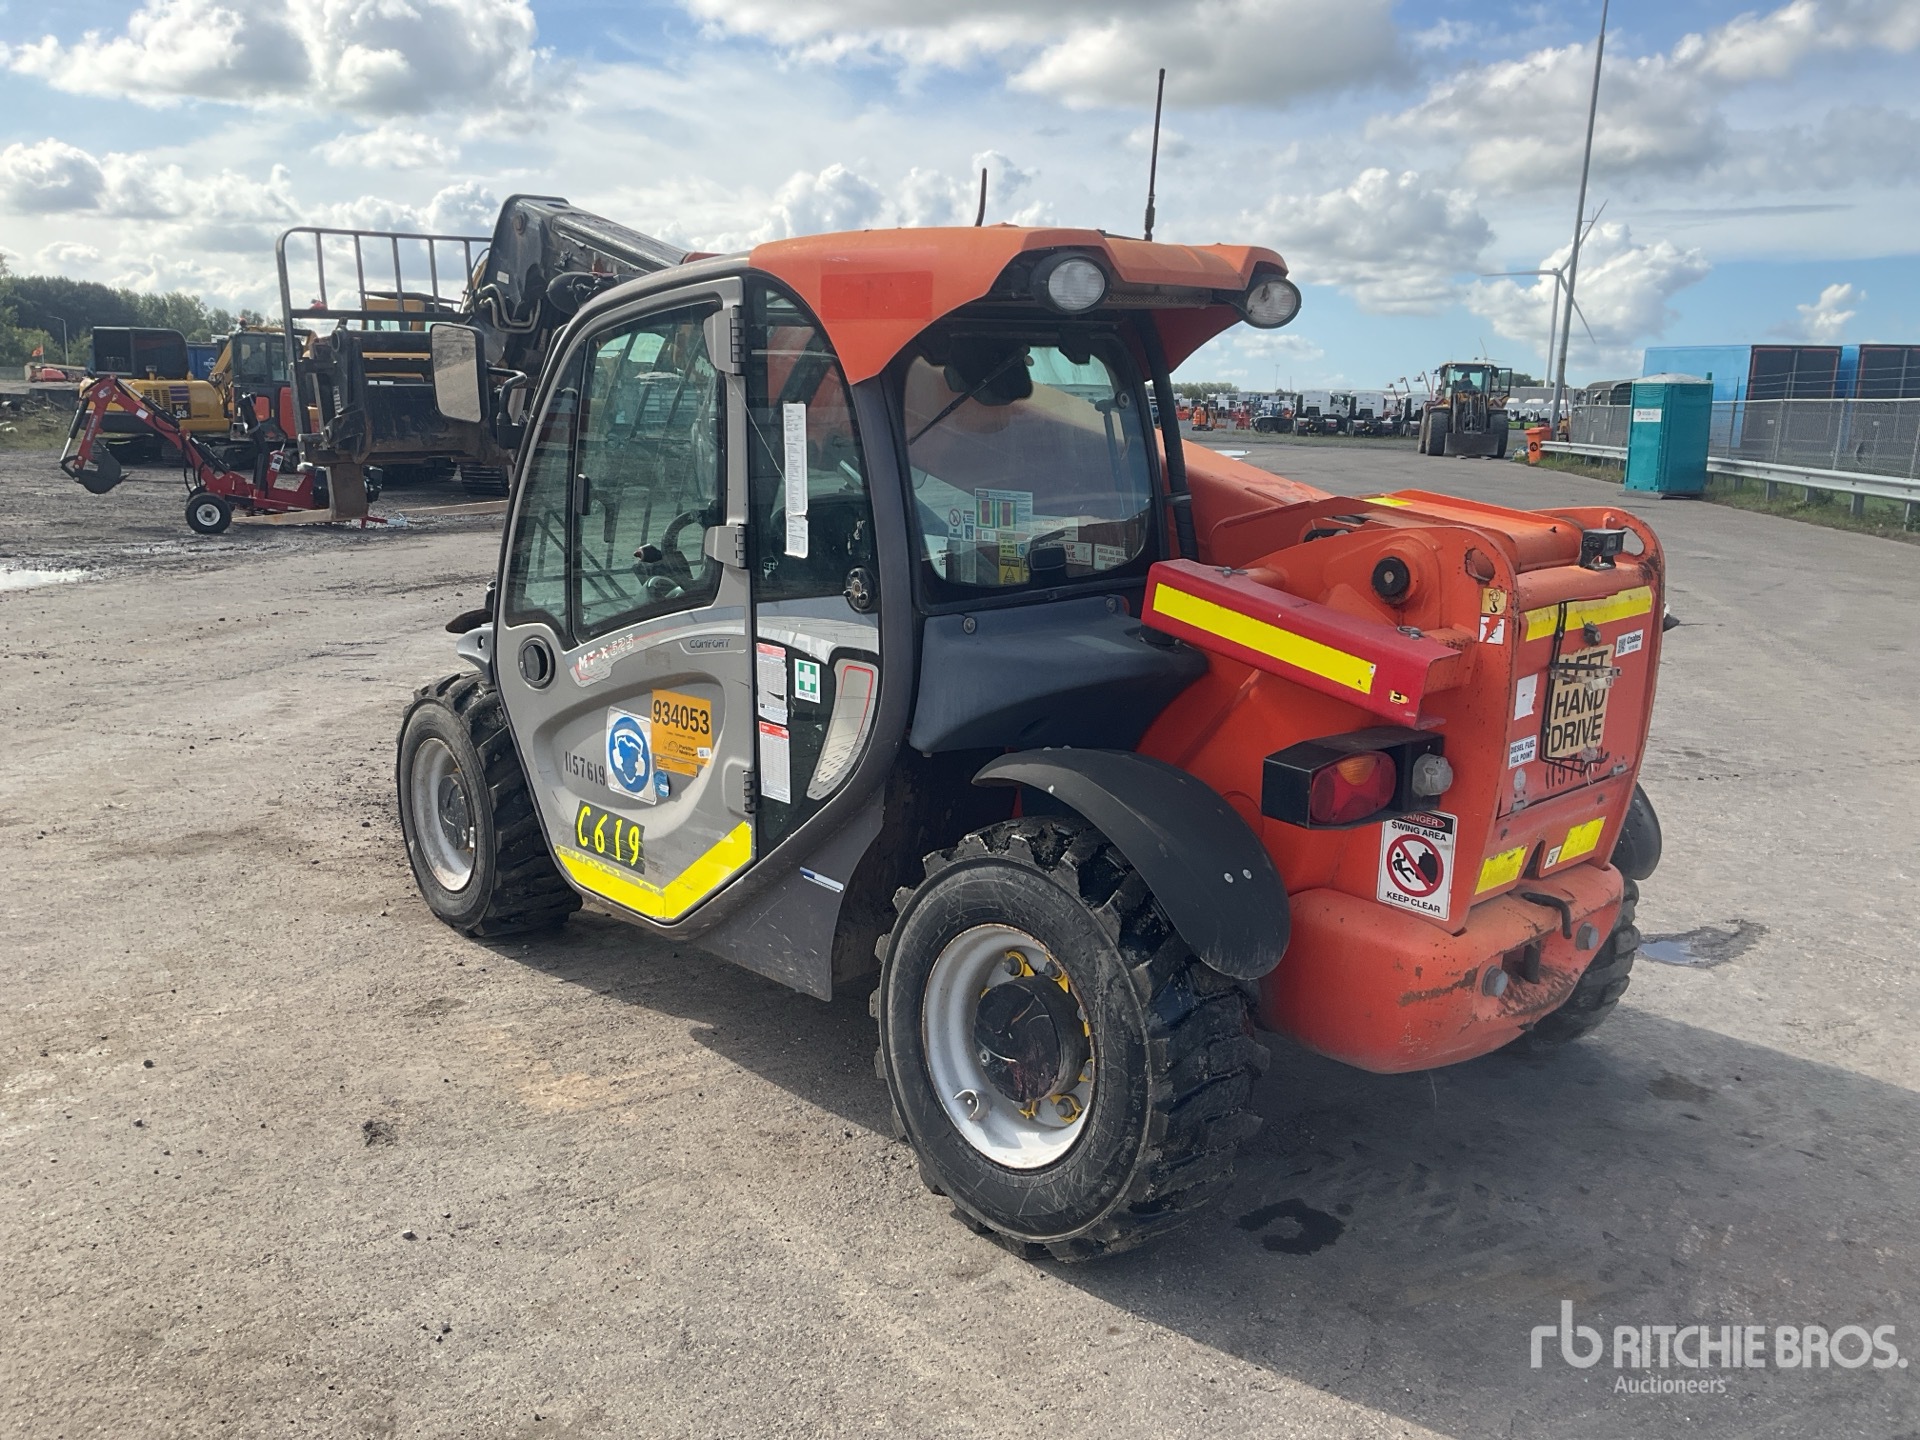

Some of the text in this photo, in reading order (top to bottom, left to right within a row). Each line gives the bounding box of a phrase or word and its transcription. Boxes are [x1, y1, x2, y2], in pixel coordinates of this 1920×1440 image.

[689, 638, 731, 649] COMFORT
[1554, 686, 1606, 719] HAND
[653, 699, 710, 735] 934053
[1525, 739, 1535, 749] FUEL
[1550, 713, 1604, 753] DRIVE
[1520, 750, 1533, 761] POINT
[565, 751, 606, 786] 1157619
[1402, 813, 1438, 827] ANGER
[1391, 821, 1447, 842] SWING AREA
[1386, 890, 1441, 913] KEEP CLEAR
